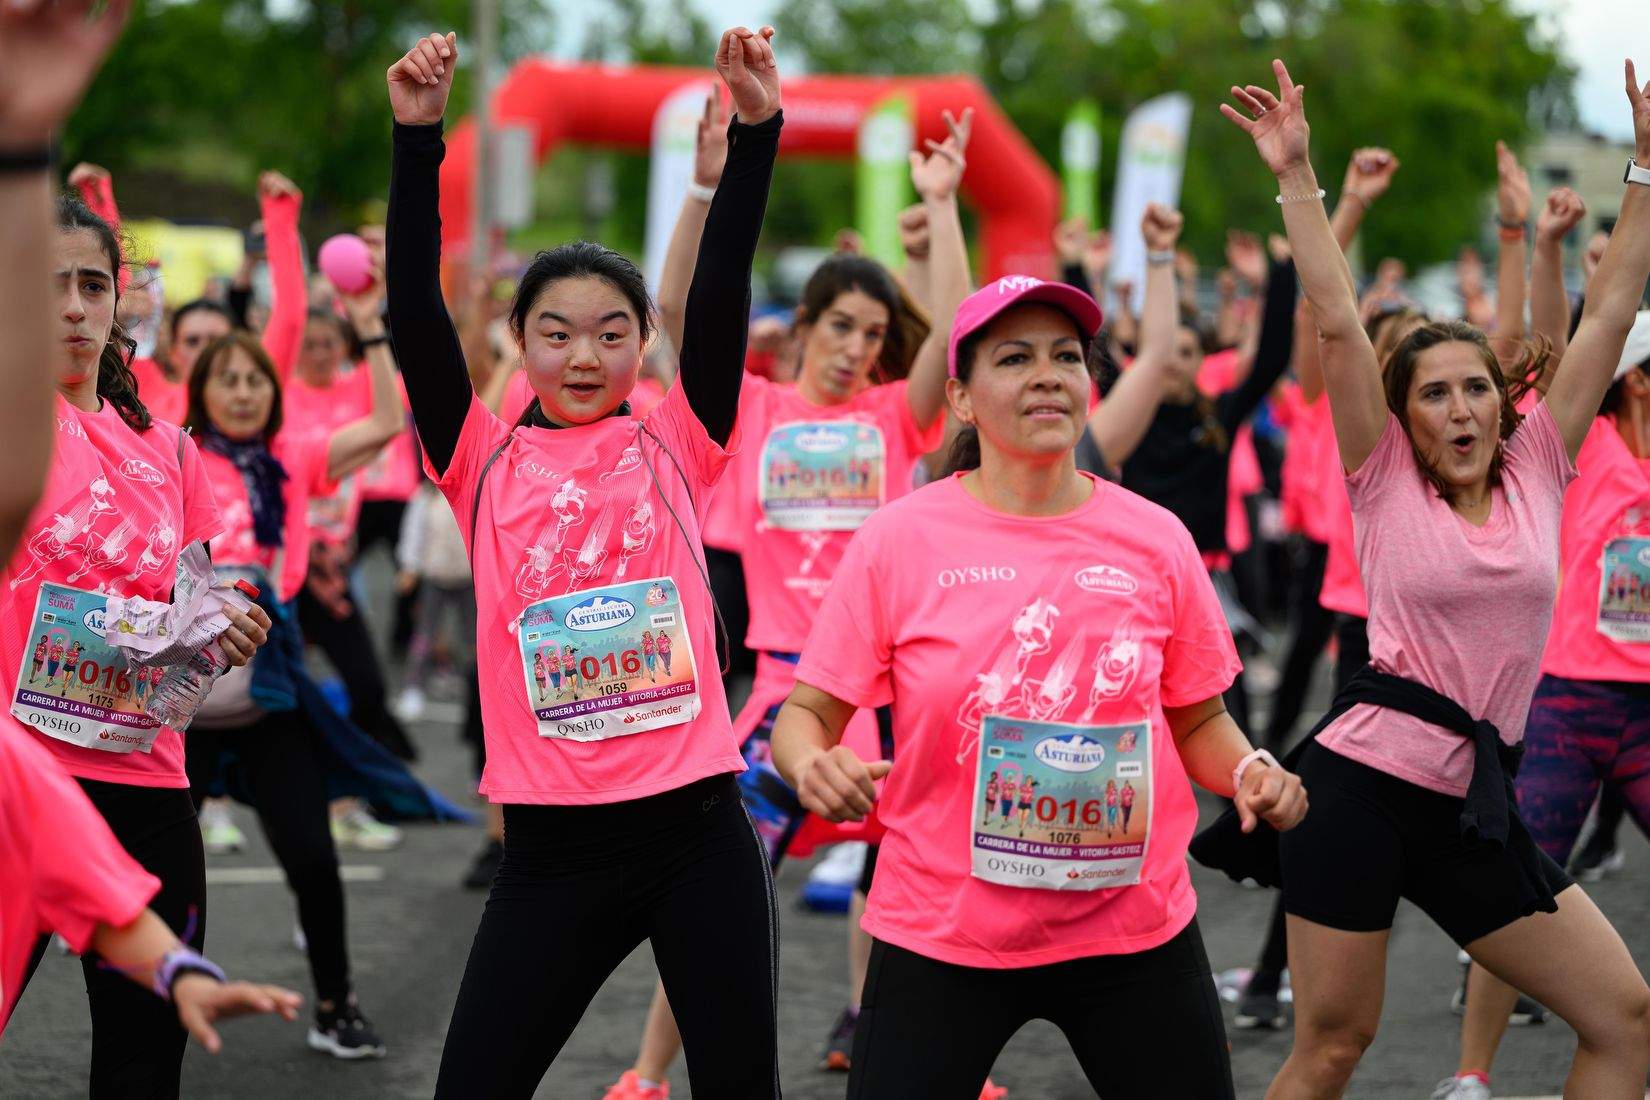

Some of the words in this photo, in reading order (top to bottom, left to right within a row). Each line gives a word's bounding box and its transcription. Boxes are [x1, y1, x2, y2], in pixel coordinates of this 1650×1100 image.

[57, 418, 89, 440] YSH
[937, 566, 1017, 588] OYSHO
[48, 598, 75, 612] SUMA
[528, 614, 554, 627] SUMA
[570, 608, 632, 628] ASTURIANA
[78, 659, 131, 694] 016
[580, 650, 641, 682] 016
[598, 682, 628, 696] 1059
[22, 692, 56, 708] CARRERA
[58, 700, 69, 710] DE
[70, 702, 80, 713] LA
[82, 706, 105, 718] MUJER
[110, 712, 156, 726] VITORIA-GAS
[88, 693, 114, 708] 1175
[540, 706, 575, 718] CARRERA
[576, 704, 586, 712] DE
[586, 701, 596, 710] LA
[598, 696, 623, 708] MUJER
[628, 684, 692, 703] VITORIA-GASTEIZ
[28, 712, 82, 734] OYSHO
[557, 718, 604, 736] OYSHO
[636, 705, 682, 722] Santander
[1036, 794, 1102, 826] 016
[977, 836, 1015, 850] CARRERA
[1016, 842, 1027, 852] DE
[1029, 844, 1040, 854] LA
[1042, 846, 1072, 856] MUJER
[1049, 832, 1080, 844] 1076
[987, 858, 1045, 878] OYSHO
[1080, 868, 1126, 879] Santander
